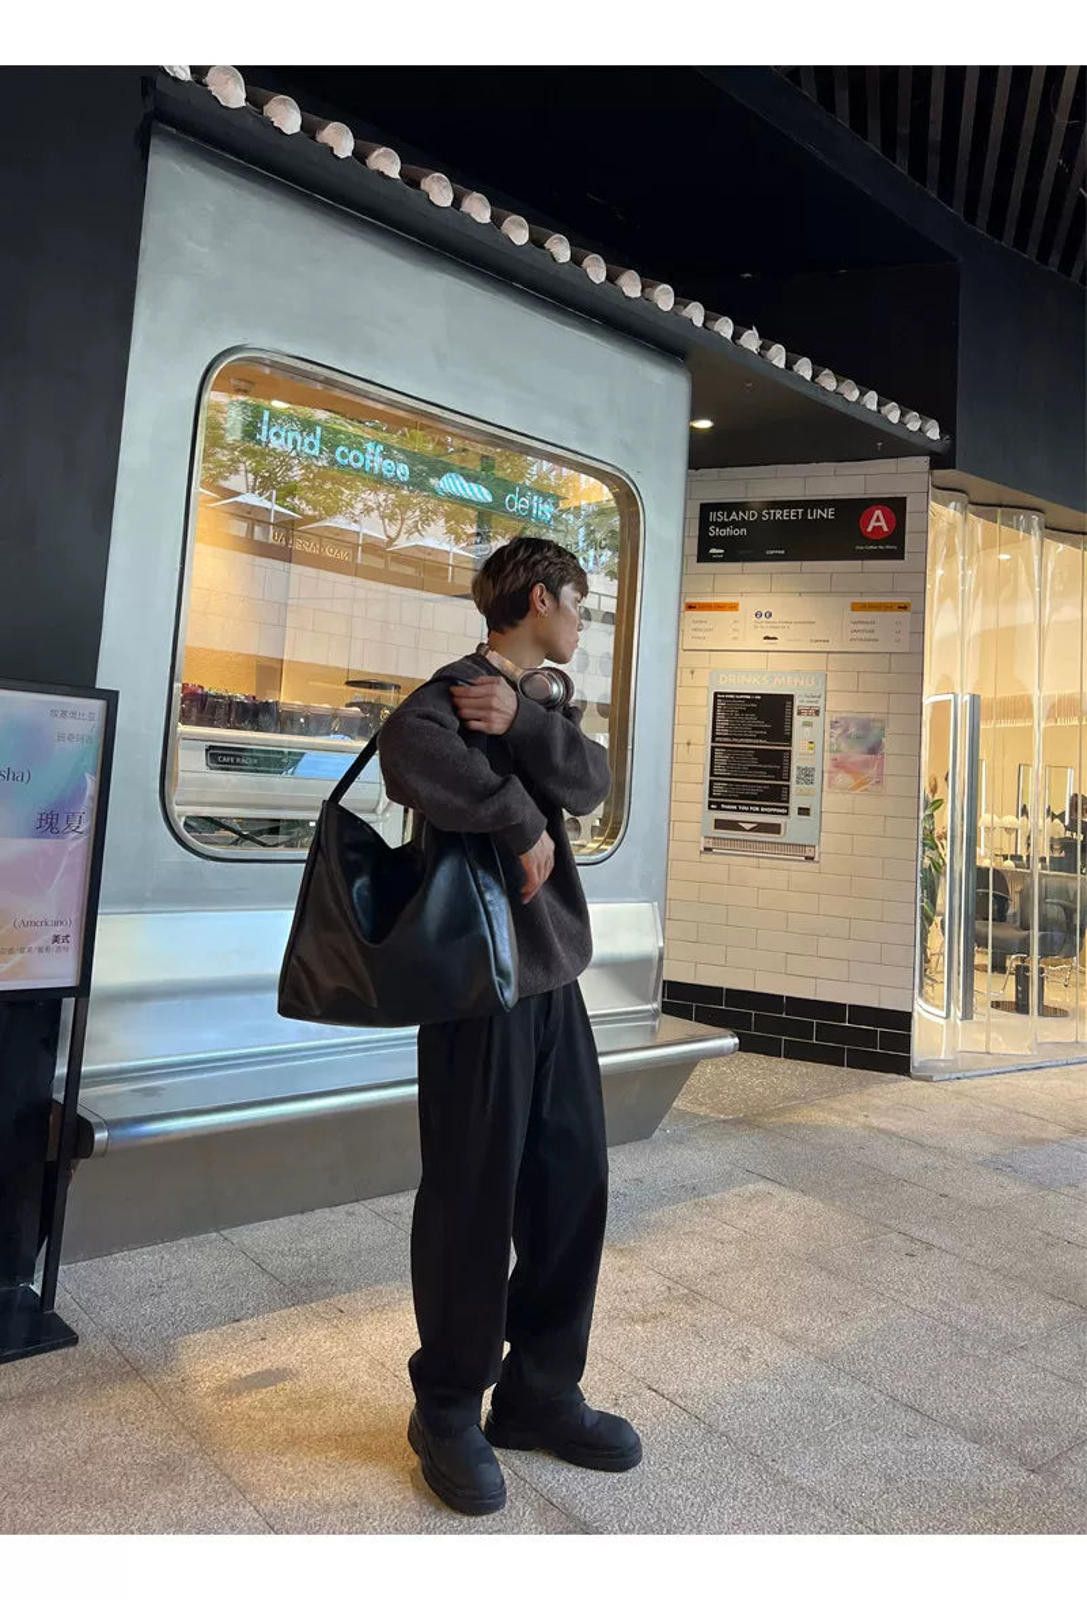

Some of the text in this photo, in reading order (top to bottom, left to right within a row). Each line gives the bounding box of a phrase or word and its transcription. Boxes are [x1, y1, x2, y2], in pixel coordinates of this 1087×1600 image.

[335, 441, 410, 482] coffee
[708, 507, 836, 522] IISLAND STREET LINE
[866, 509, 889, 533] A
[708, 525, 747, 537] Station
[719, 673, 816, 687] DRINKS MENU
[218, 755, 235, 764] CAFE
[35, 809, 86, 835] 瑰夏
[13, 916, 72, 929] (Americano)
[51, 934, 71, 945] 美式
